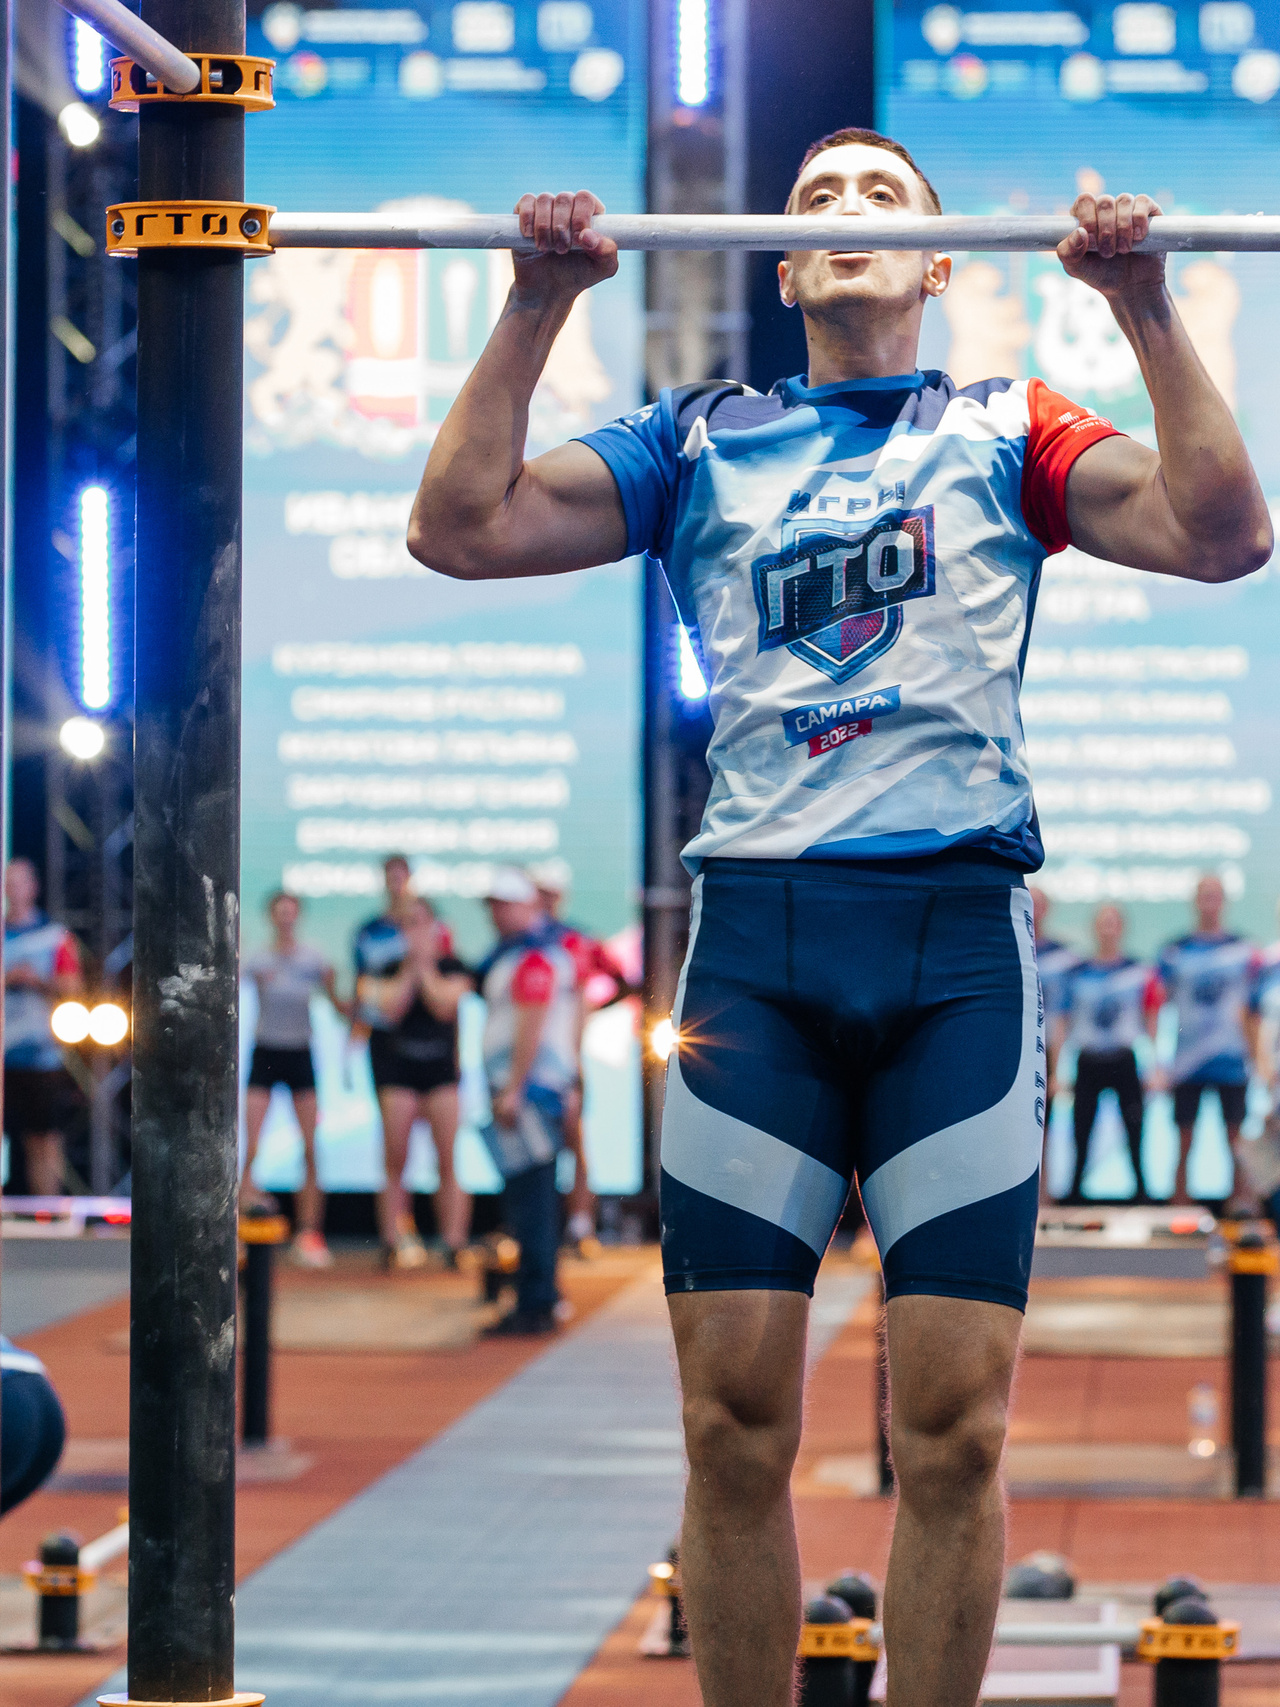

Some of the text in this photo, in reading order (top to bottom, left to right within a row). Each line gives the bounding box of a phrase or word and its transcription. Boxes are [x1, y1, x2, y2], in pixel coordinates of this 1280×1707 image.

[136, 213, 228, 236] ГТО
[786, 480, 906, 514] ИГРЫ
[766, 529, 914, 630] ГТО
[795, 694, 892, 733] САМАРА
[820, 722, 859, 750] 2022
